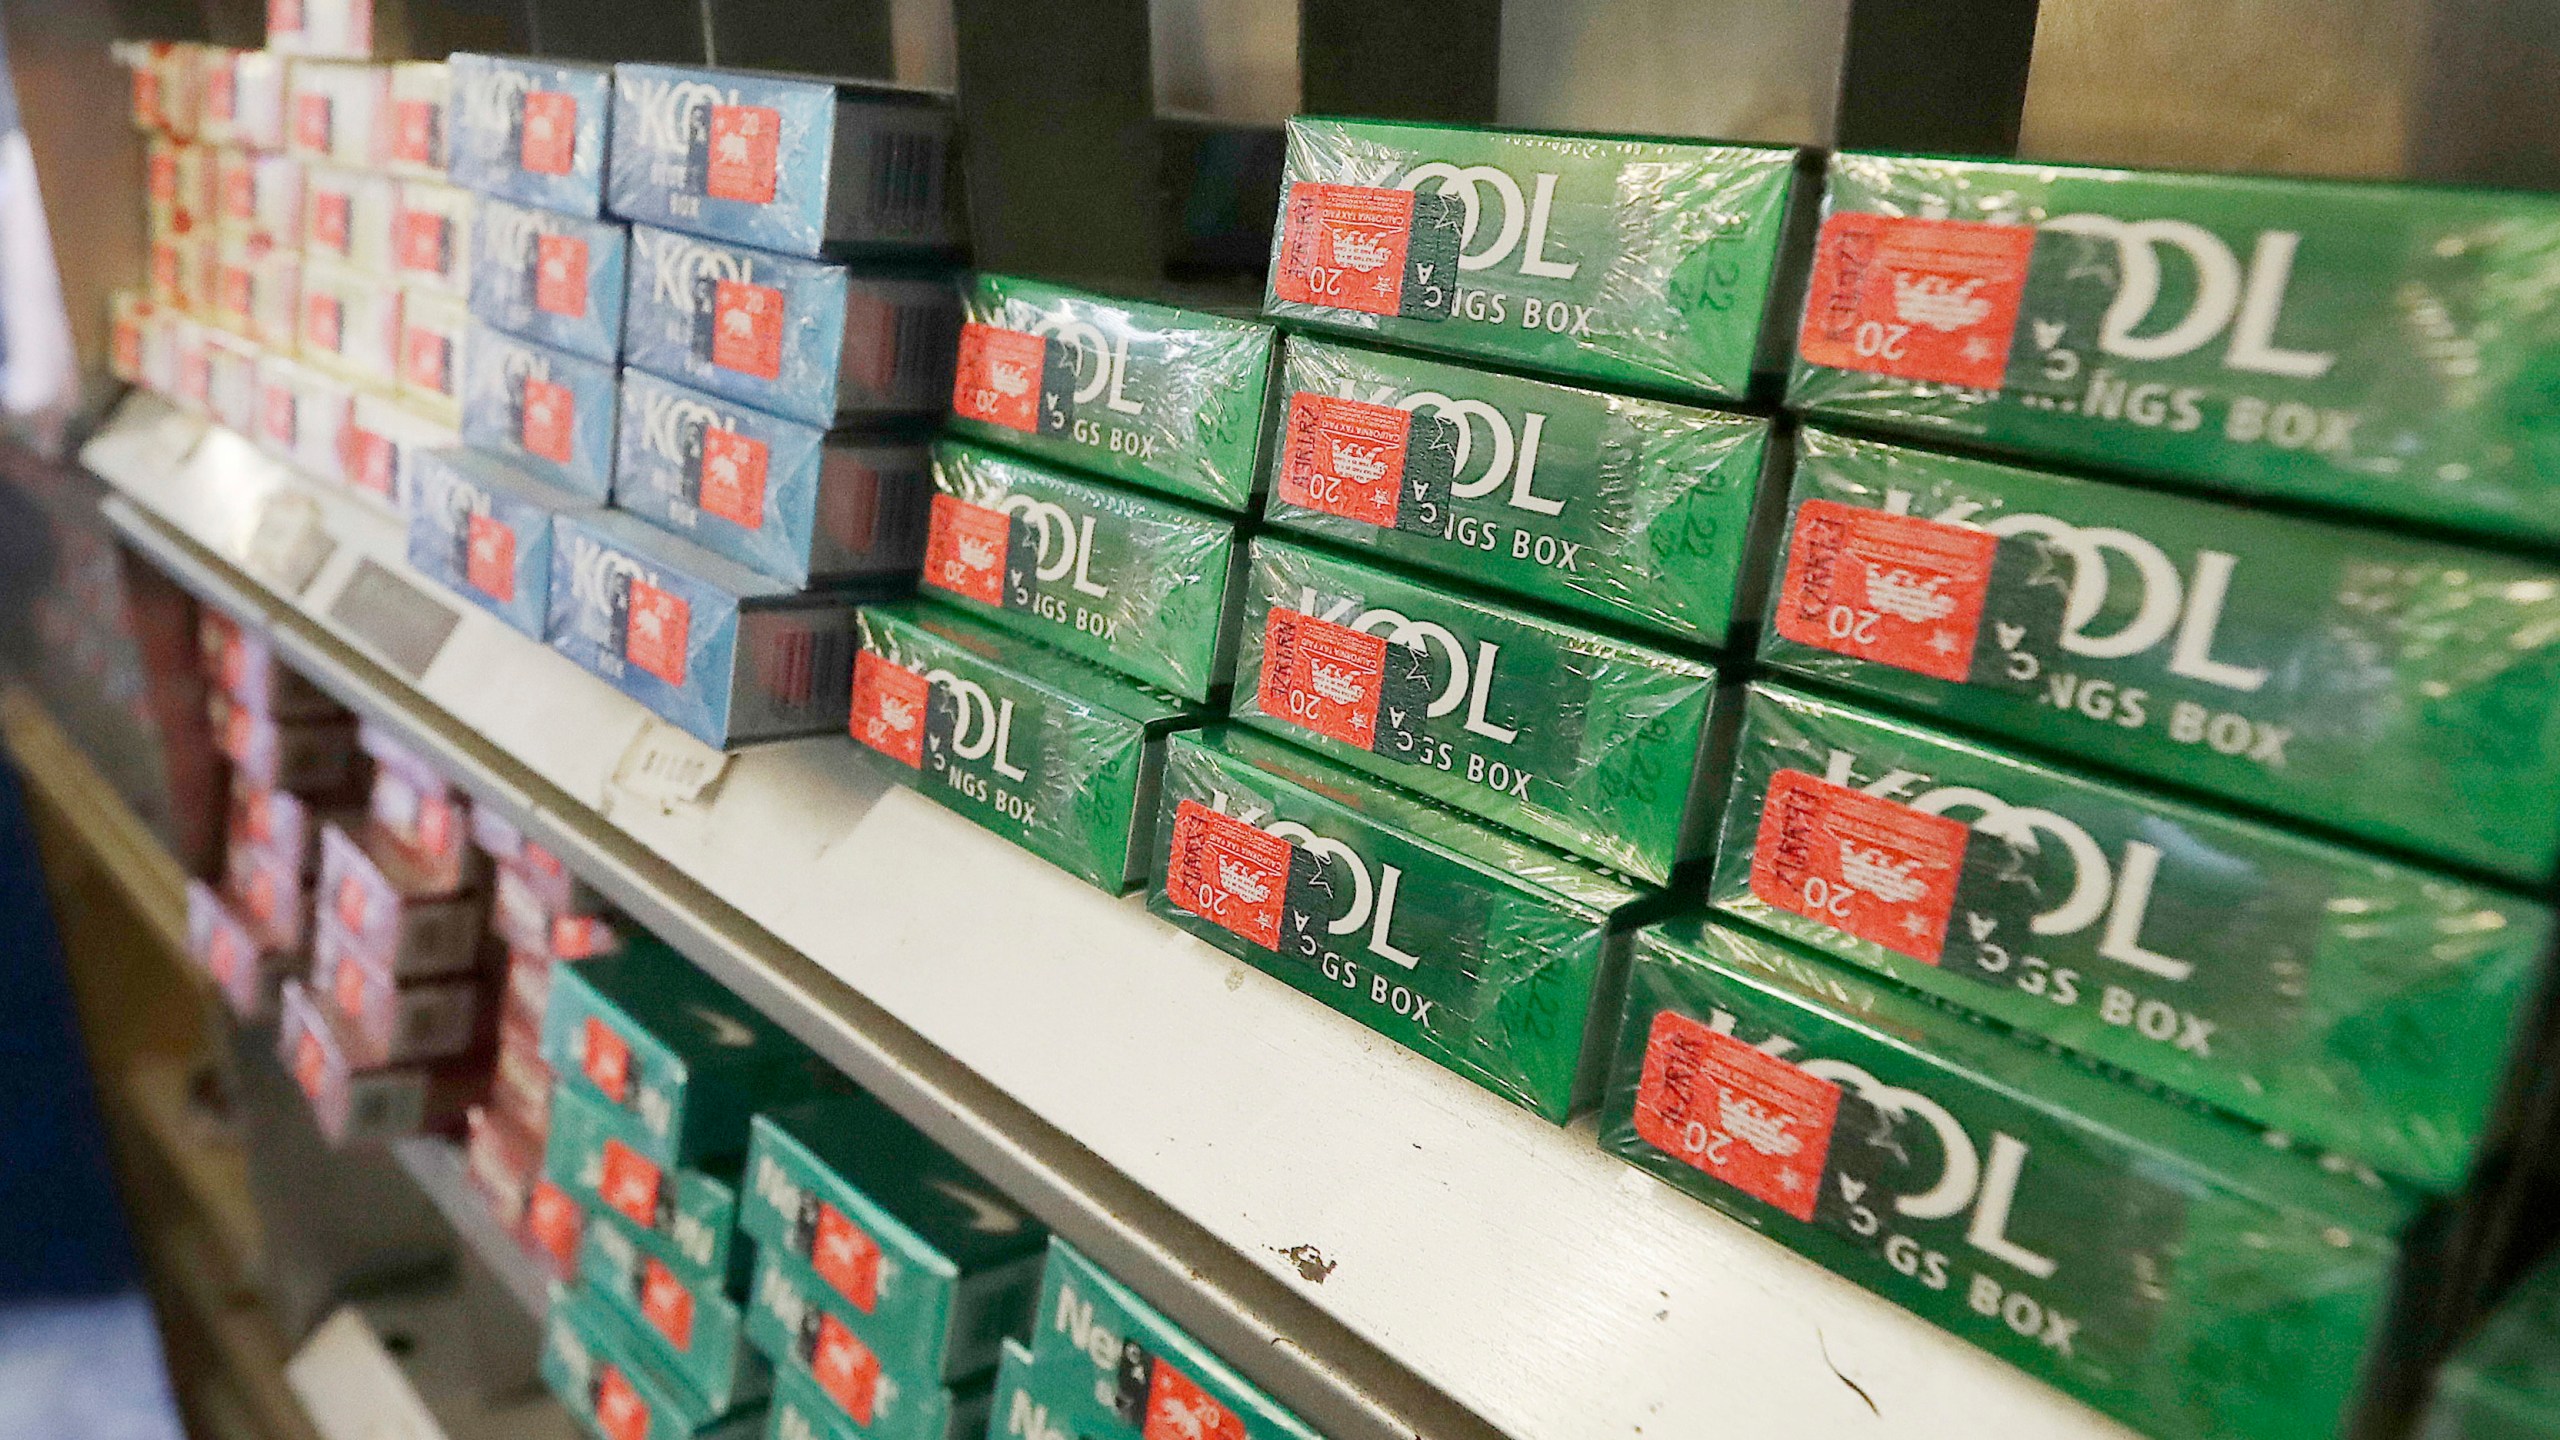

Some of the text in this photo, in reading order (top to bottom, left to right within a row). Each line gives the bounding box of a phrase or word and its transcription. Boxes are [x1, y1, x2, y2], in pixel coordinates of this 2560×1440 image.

[1341, 159, 1578, 280] OL
[1342, 211, 1357, 221] TAX
[1358, 211, 1404, 226] CALIFORNIA
[1309, 264, 1343, 297] 20
[1915, 196, 2334, 378] OL
[1522, 297, 1593, 337] BOX
[1855, 319, 1910, 361] 20
[1015, 319, 1144, 415] OL
[1110, 427, 1155, 460] BOX
[1339, 423, 1355, 434] TAX
[1356, 425, 1401, 442] CALIFORNIA
[2227, 395, 2360, 453] BOX
[1339, 377, 1567, 516] OL
[1310, 473, 1342, 502] 20
[980, 494, 1108, 598] OL
[1512, 527, 1582, 572] BOX
[1886, 491, 2267, 690] OL
[1075, 607, 1118, 642] BOX
[1827, 604, 1880, 645] 20
[1301, 586, 1519, 744] OL
[1318, 643, 1333, 655] TAX
[1334, 648, 1378, 668] CALIFORNIA
[908, 668, 1028, 783] OL
[1290, 689, 1321, 720] 20
[2169, 699, 2292, 766] BOX
[1466, 758, 1533, 803] BOX
[995, 788, 1036, 827] BOX
[1227, 842, 1240, 853] TAX
[1241, 845, 1282, 871] CALIFORNIA
[1825, 749, 2193, 982] OL
[1198, 883, 1229, 915] 20
[1213, 791, 1420, 970] OL
[1803, 876, 1856, 918] 20
[1371, 974, 1433, 1028] BOX
[2100, 984, 2218, 1058] BOX
[1685, 1120, 1729, 1165] 20
[1709, 1006, 2057, 1280] OL
[1969, 1274, 2079, 1356] BOX
